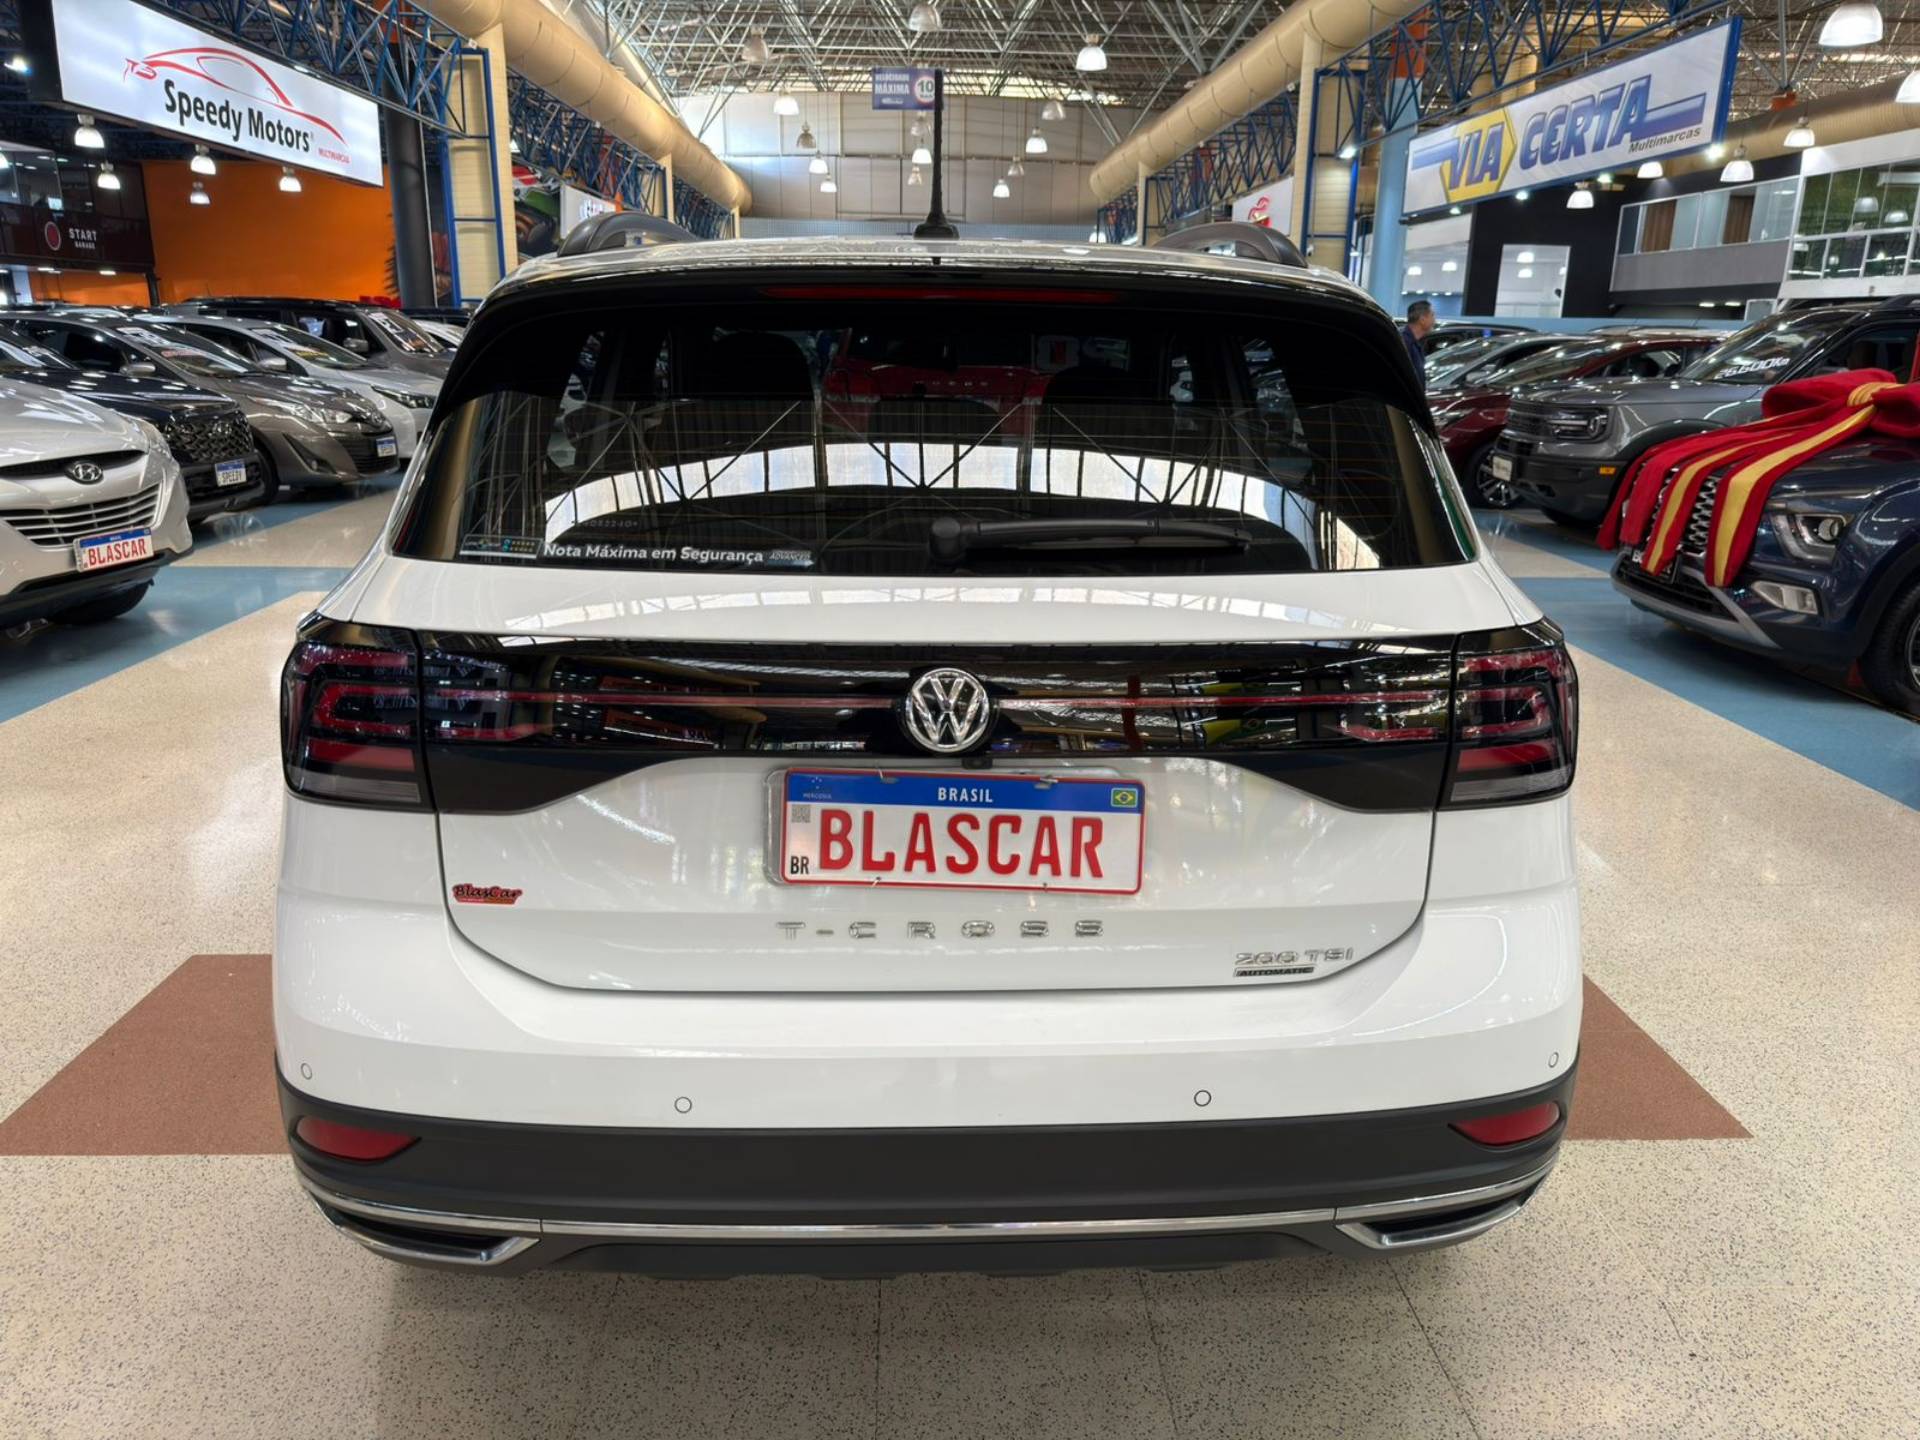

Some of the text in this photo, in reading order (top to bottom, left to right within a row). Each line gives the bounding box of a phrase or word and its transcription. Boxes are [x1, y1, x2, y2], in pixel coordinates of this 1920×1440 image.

[917, 80, 935, 92] 10
[164, 78, 310, 152] Speedy Motors
[1448, 74, 1652, 191] VIA CERTA
[1628, 127, 1702, 154] Multimarcas
[69, 227, 97, 242] START
[88, 538, 147, 566] BLASCAR
[543, 543, 764, 565] Nota Máxima em Segurança
[937, 786, 994, 803] BRASIL
[819, 808, 1104, 878] BLASCAR
[790, 855, 810, 875] BR
[776, 920, 1105, 940] T-CROSS
[1235, 947, 1354, 966] 200 TSI
[1236, 966, 1315, 977] AUTOMATIC
